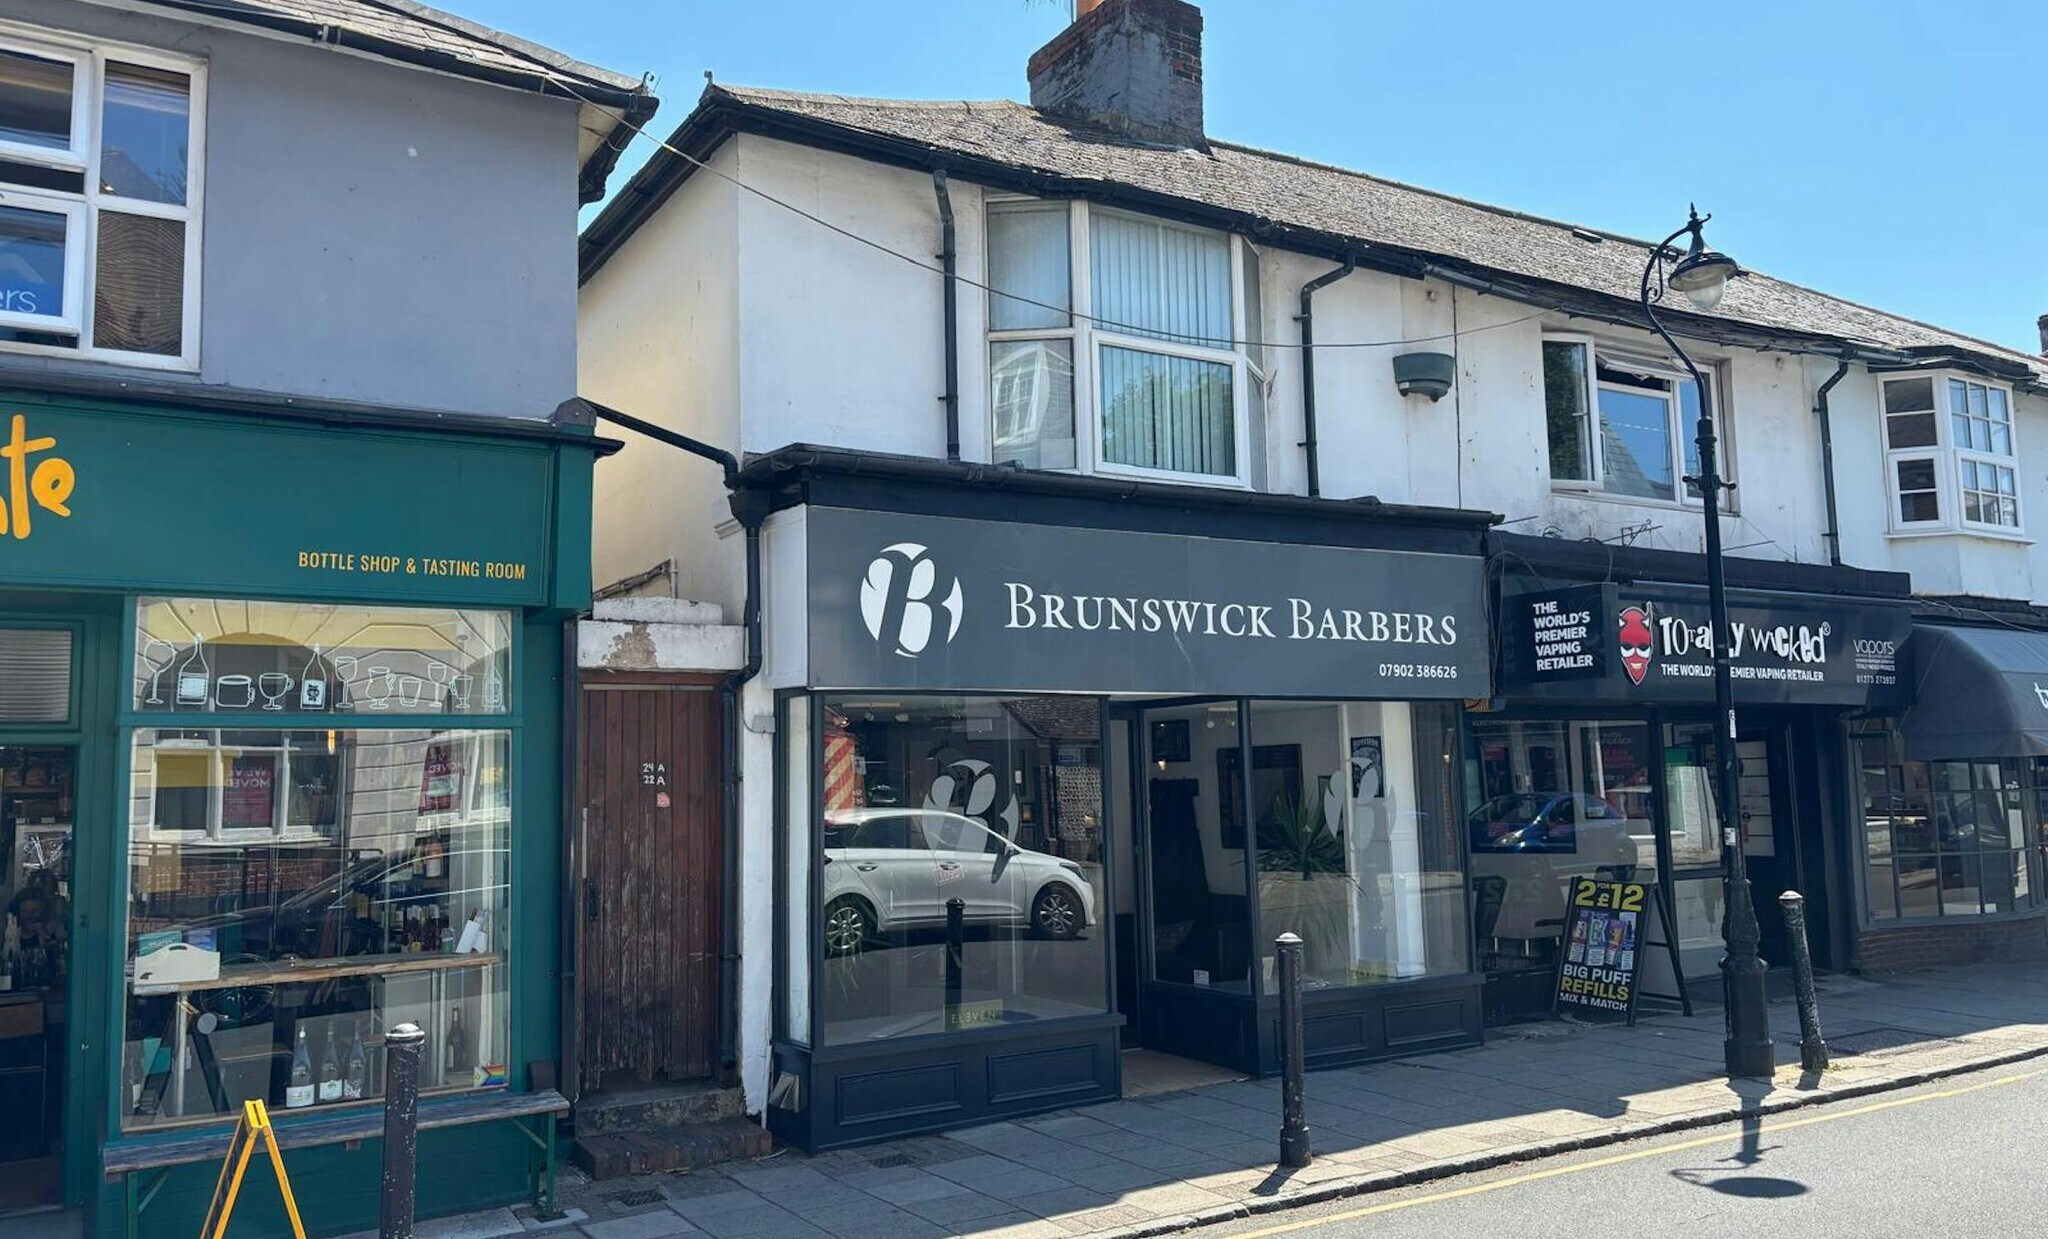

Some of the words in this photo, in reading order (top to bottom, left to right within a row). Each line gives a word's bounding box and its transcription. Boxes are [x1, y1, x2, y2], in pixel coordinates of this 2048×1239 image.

[299, 552, 354, 570] BOTTLE
[361, 554, 400, 573] SHOP
[406, 558, 416, 574] &
[422, 558, 479, 577] TASTING
[486, 562, 525, 580] ROOM
[1004, 581, 1276, 639] BRUNSWICK
[1287, 598, 1457, 646] BARBERS
[1532, 600, 1559, 616] THE
[1533, 610, 1591, 630] WORLD'S
[1534, 626, 1588, 644] PREMIER
[1535, 641, 1582, 657] VAPING
[1379, 663, 1414, 678] 07902
[1416, 665, 1458, 680] 386626
[1536, 654, 1594, 672] RETAILER
[1660, 663, 1680, 677] THE
[1729, 666, 1756, 679] EMIER
[1756, 667, 1787, 680] VAPING
[1786, 668, 1824, 682] RETAILER
[1575, 880, 1597, 907] 2
[1563, 963, 1588, 980] BIG
[1591, 967, 1632, 986] PUFF
[1559, 975, 1630, 1002] REFILLS
[1559, 992, 1579, 1004] MIX
[1580, 994, 1589, 1006] &
[1590, 996, 1628, 1012] MATCH
